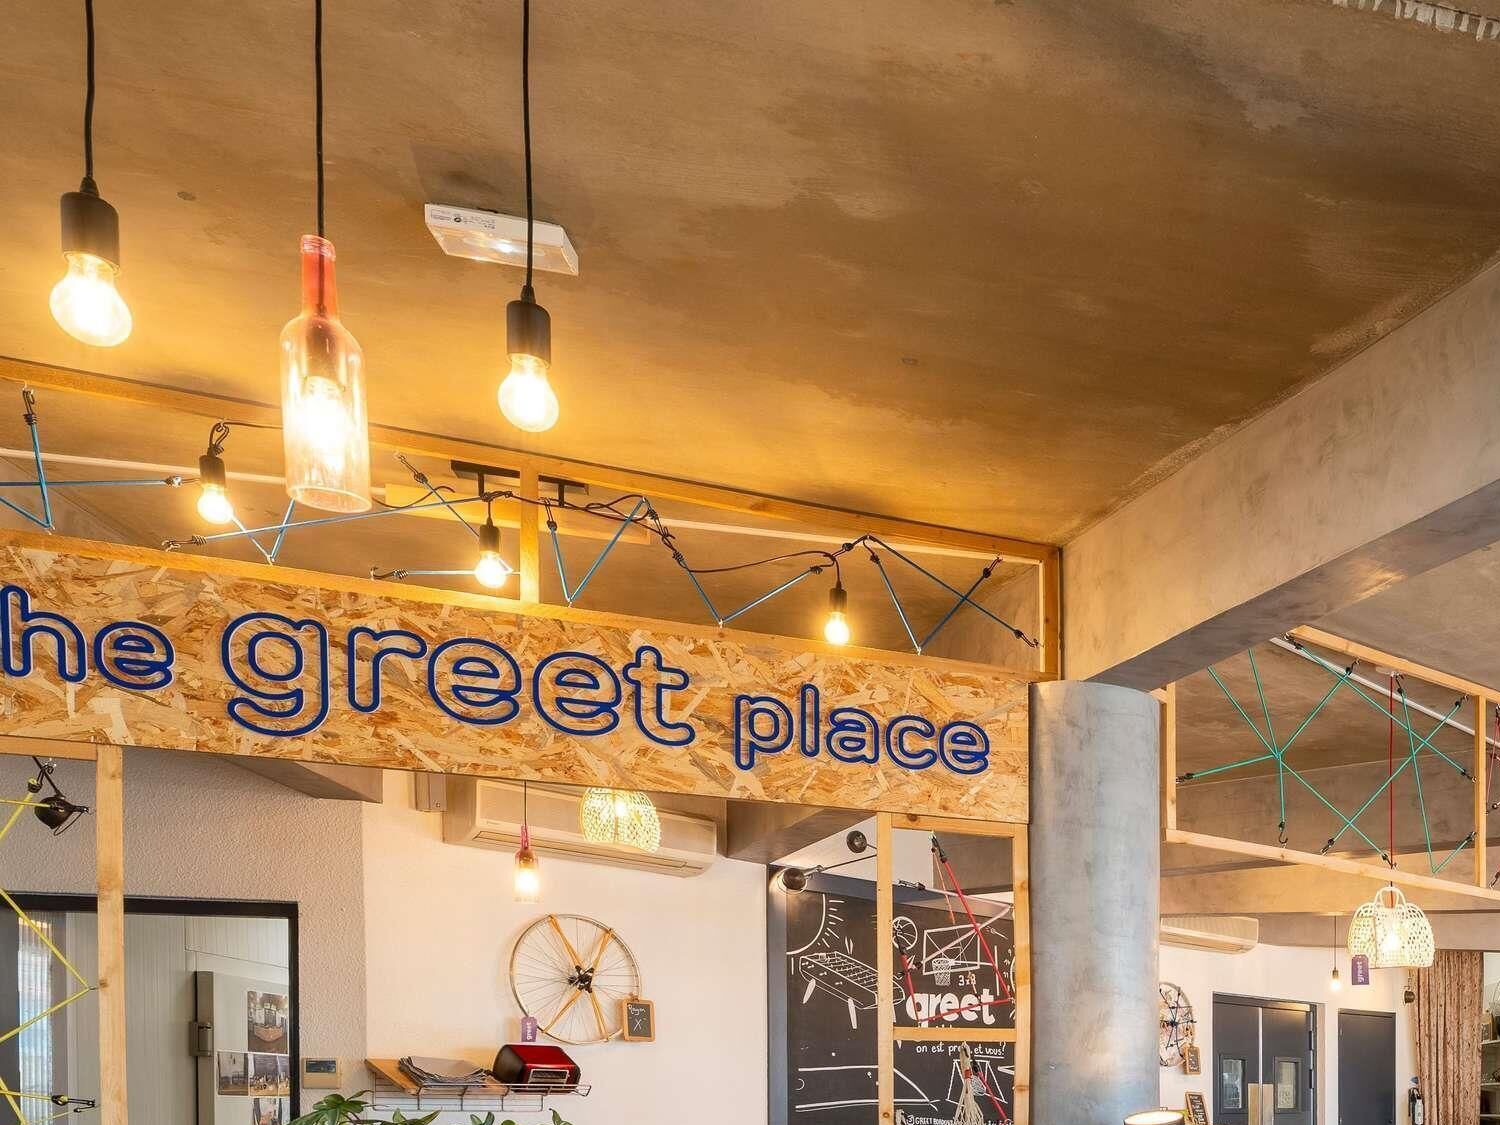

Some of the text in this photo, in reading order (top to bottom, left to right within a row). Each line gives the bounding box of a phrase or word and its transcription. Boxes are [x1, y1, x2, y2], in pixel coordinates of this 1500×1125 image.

[0, 585, 991, 775] he greet place
[905, 988, 996, 1028] greet
[916, 1044, 927, 1053] on
[931, 1042, 944, 1053] est
[974, 1043, 983, 1054] et
